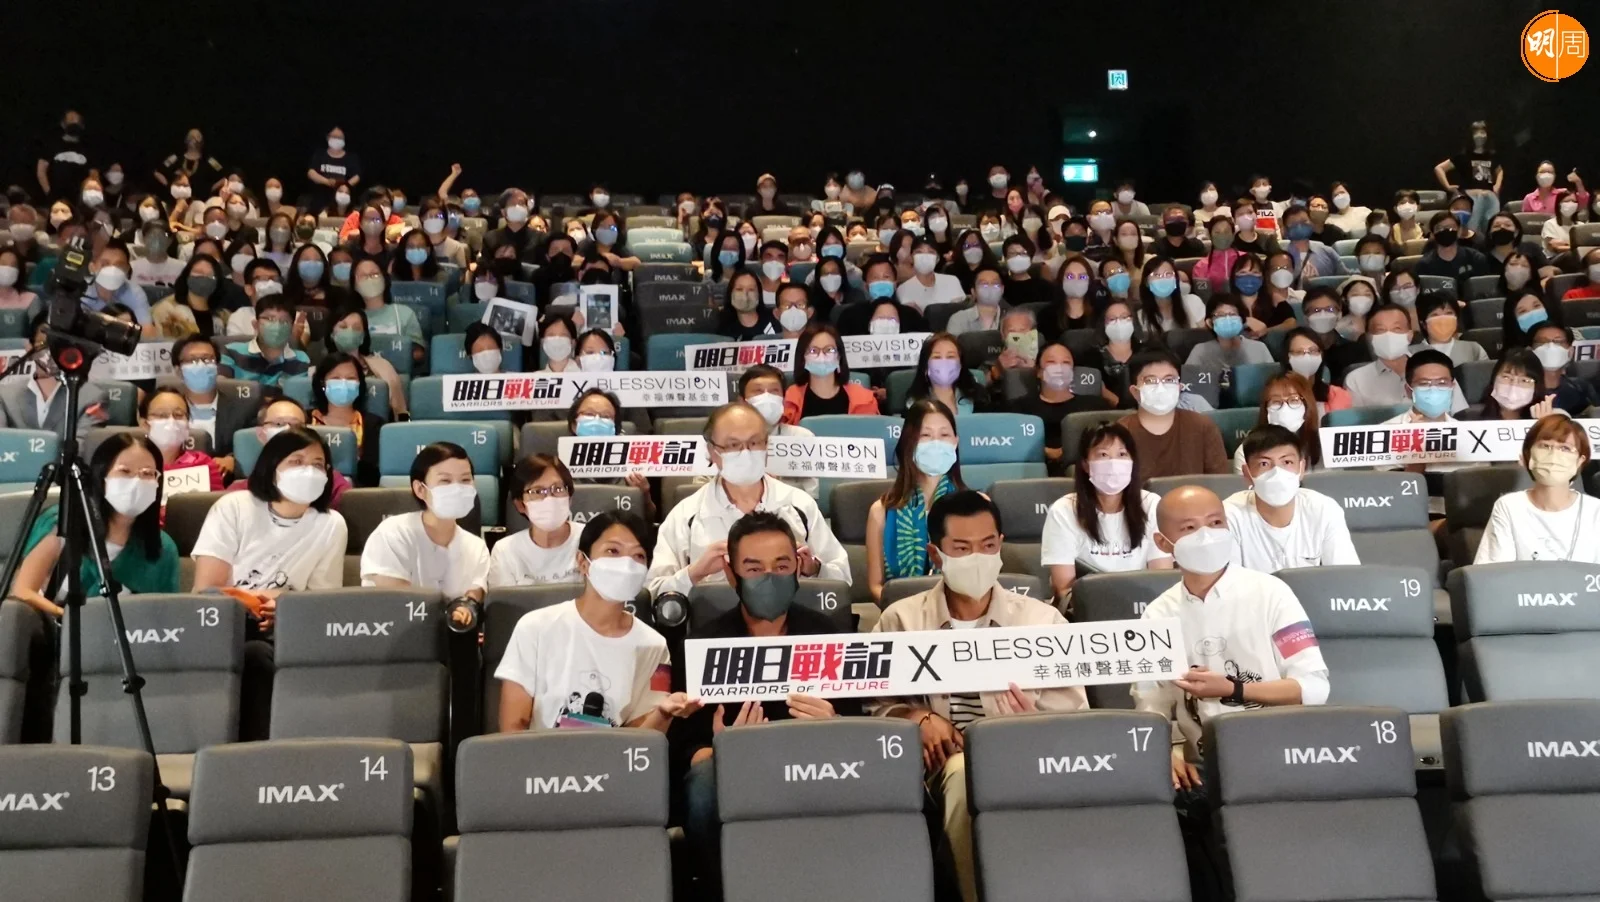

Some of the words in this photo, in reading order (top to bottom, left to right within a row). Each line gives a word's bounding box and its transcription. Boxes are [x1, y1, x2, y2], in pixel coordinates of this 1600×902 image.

[692, 286, 701, 295] 17
[666, 318, 695, 326] IMAX
[703, 309, 712, 318] 17
[846, 339, 923, 352] ESSVISIO
[1080, 373, 1095, 385] 20
[1198, 372, 1211, 384] 21
[108, 388, 121, 400] 12
[237, 386, 250, 398] 13
[453, 378, 563, 401] 明日戰記
[597, 377, 720, 390] BLESSVISION
[471, 430, 487, 445] 15
[887, 425, 901, 438] 18
[1020, 423, 1035, 437] 19
[28, 438, 46, 453] 12
[326, 433, 341, 447] 14
[970, 436, 1014, 447] IMAX
[1333, 427, 1458, 456] 明日戰記
[1468, 429, 1492, 453] X
[569, 441, 697, 466] 明日戰記
[766, 443, 877, 459] ESSVISION
[1332, 455, 1391, 464] WARRIORS
[1411, 452, 1457, 460] FUTURE
[1401, 480, 1420, 496] 21
[614, 495, 631, 511] 16
[1344, 496, 1394, 509] IMAX
[1400, 579, 1421, 597] 19
[816, 592, 837, 611] 16
[1330, 597, 1390, 612] IMAX
[1517, 592, 1577, 607] IMAX
[197, 607, 220, 627] 13
[405, 601, 428, 621] 14
[125, 627, 184, 644] MAX
[326, 621, 393, 637] IMAX
[702, 641, 893, 685] 明日戰記
[907, 644, 942, 682] X
[952, 628, 1173, 662] BLESSVISION
[1033, 656, 1174, 680] 幸福傳聲基金會
[700, 684, 790, 697] WARRIORS
[820, 681, 890, 692] FUTURE
[1127, 726, 1154, 752] 17
[1371, 720, 1397, 744] 18
[876, 734, 904, 759] 16
[1527, 741, 1600, 758] IMAX
[623, 747, 650, 772] 15
[1038, 754, 1116, 774] IMAX
[1284, 746, 1360, 765] IMAX
[360, 756, 388, 782] 14
[784, 761, 864, 782] IMAX
[87, 766, 116, 792] 13
[525, 774, 608, 794] IMAX
[0, 791, 69, 811] MAX
[258, 783, 344, 804] IMAX
